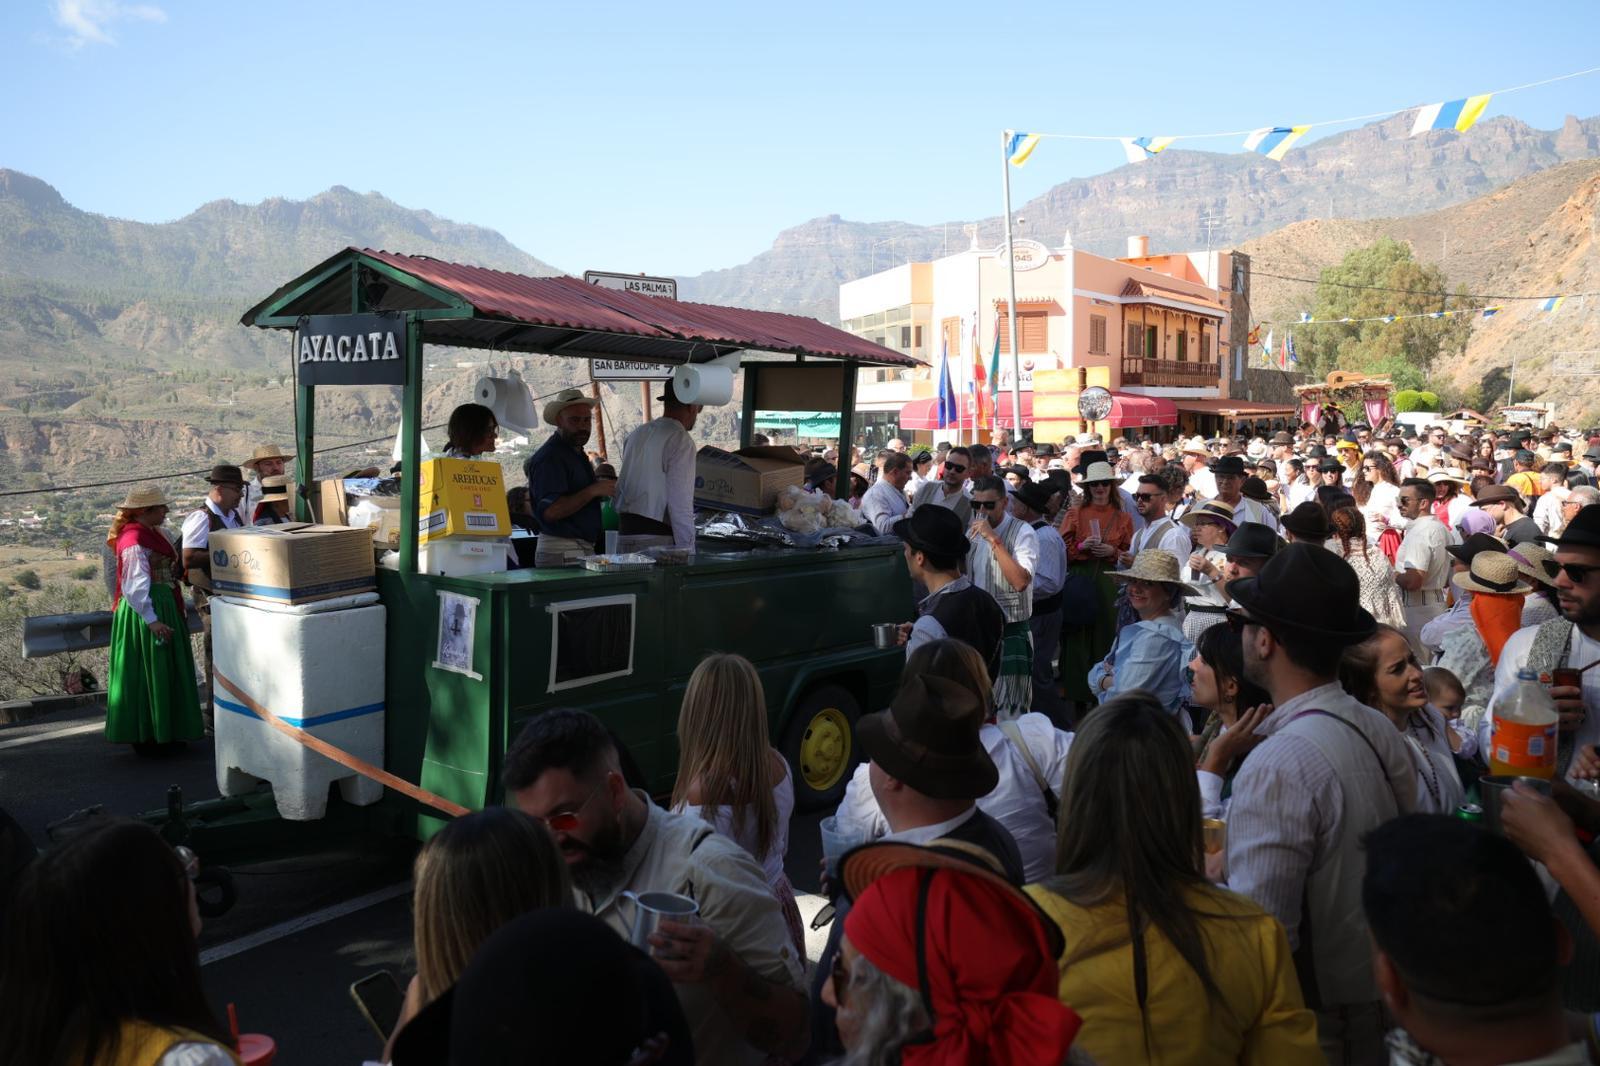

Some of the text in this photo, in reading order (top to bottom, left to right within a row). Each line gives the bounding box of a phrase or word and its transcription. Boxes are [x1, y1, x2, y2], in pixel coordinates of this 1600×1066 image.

[624, 280, 640, 291] LAS
[299, 331, 400, 363] AYACATA
[594, 361, 612, 370] SAN
[452, 473, 497, 485] AREHUCAS
